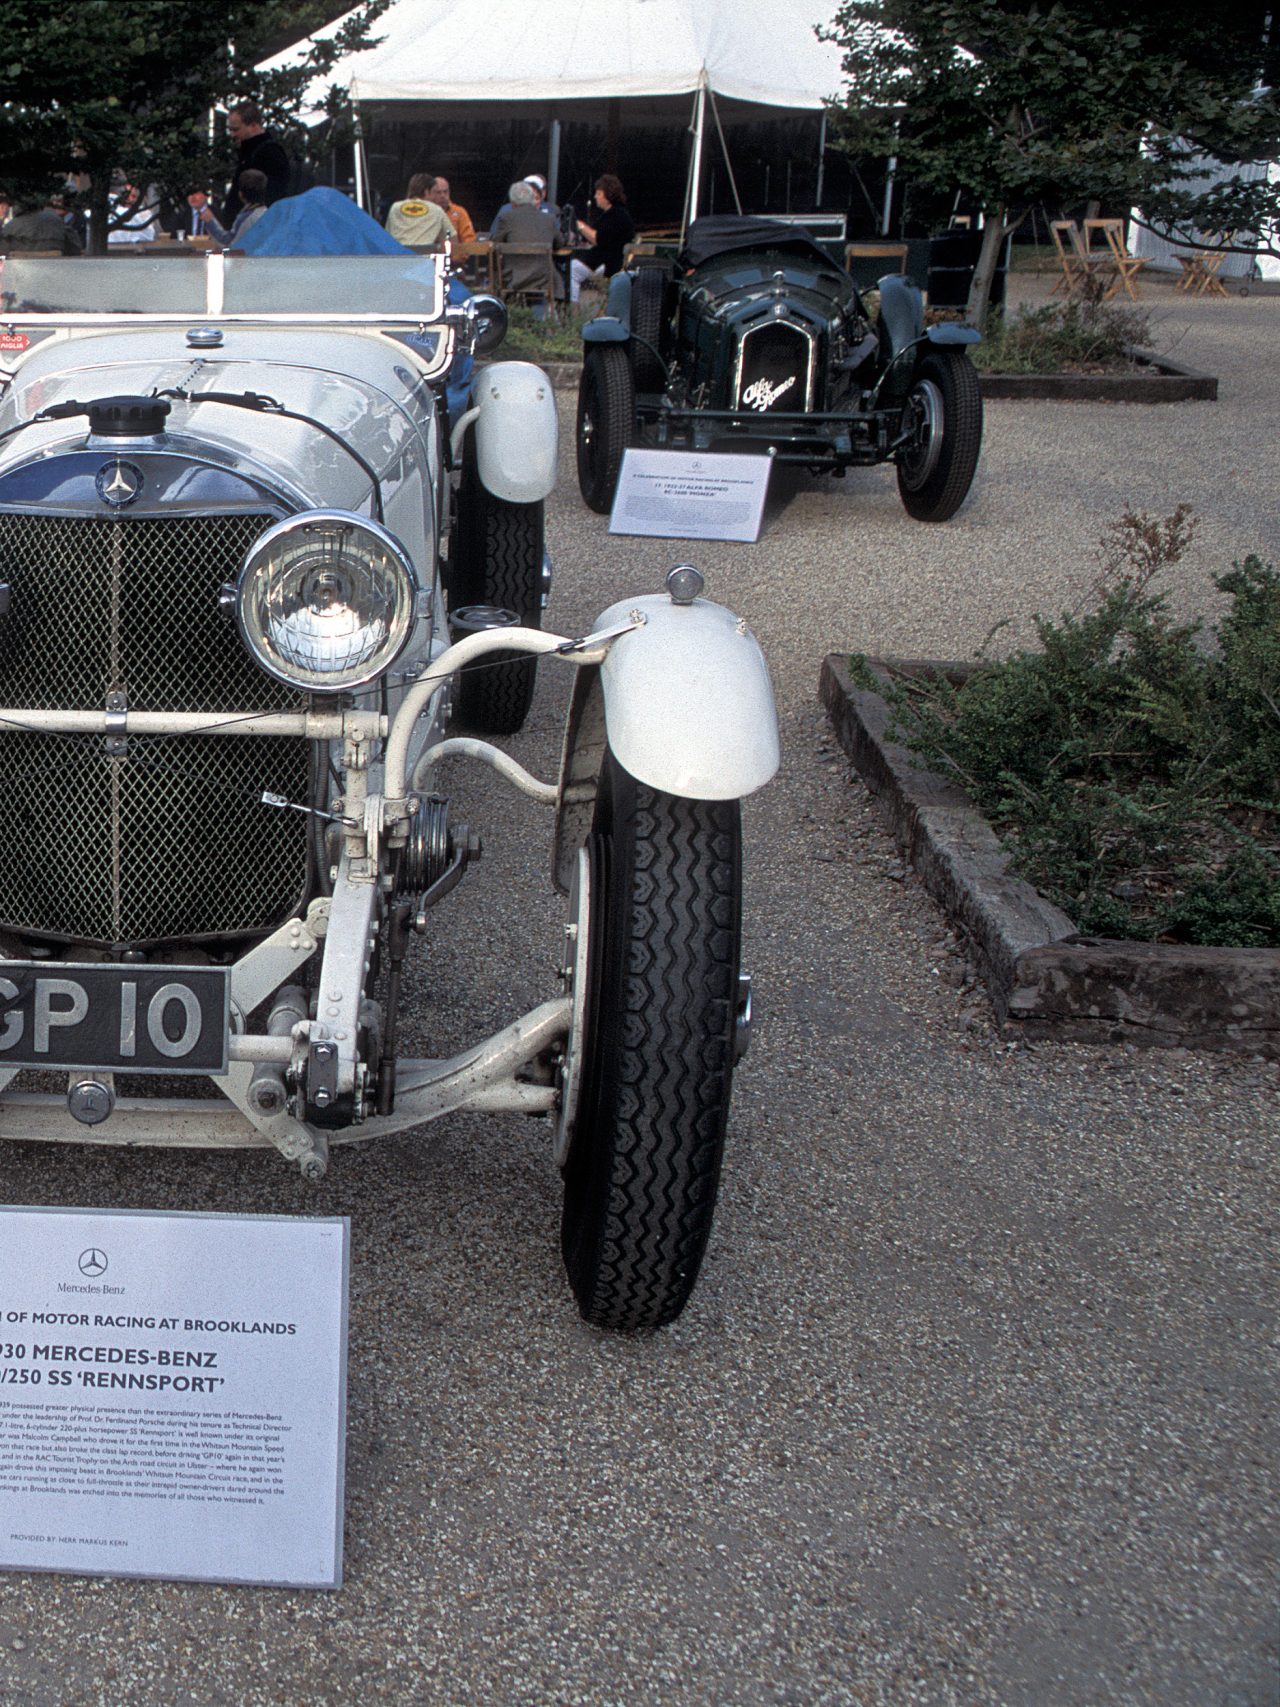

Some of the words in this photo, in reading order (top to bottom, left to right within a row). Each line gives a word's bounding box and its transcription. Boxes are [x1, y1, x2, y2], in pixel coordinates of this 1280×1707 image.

[120, 981, 203, 1059] 10
[57, 1282, 126, 1295] Mercedes-Benz
[6, 1311, 28, 1323] OF
[32, 1312, 90, 1326] MOTOR
[94, 1315, 156, 1329] RACING
[158, 1318, 179, 1330] AT
[184, 1319, 297, 1335] BROOKLANDS
[32, 1344, 218, 1368] MERCEDES-BENZ
[47, 1370, 73, 1386] SS
[1, 1410, 21, 1418] under
[22, 1411, 34, 1419] the
[35, 1412, 68, 1422] leadership
[105, 1415, 138, 1424] Ferdinand
[138, 1417, 166, 1425] Porsche
[166, 1418, 188, 1428] during
[200, 1420, 222, 1428] tenure
[232, 1422, 262, 1430] Technical
[262, 1423, 292, 1431] Director
[11, 1401, 44, 1411] possessed
[45, 1402, 69, 1412] greater
[70, 1404, 95, 1414] physical
[96, 1406, 126, 1415] presence
[127, 1406, 142, 1414] than
[143, 1407, 155, 1415] the
[156, 1408, 201, 1419] extraordinary
[202, 1410, 222, 1418] series
[231, 1411, 282, 1421] Mercedes-Benz
[26, 1422, 58, 1432] 6-cylinder
[88, 1425, 129, 1436] horsepower
[177, 1429, 184, 1437] is
[199, 1430, 223, 1439] known
[224, 1432, 243, 1440] under
[255, 1433, 280, 1443] original
[21, 1432, 49, 1440] Malcolm
[50, 1433, 82, 1444] Campbell
[83, 1435, 97, 1443] who
[98, 1436, 118, 1444] drove
[125, 1437, 136, 1445] for
[149, 1438, 163, 1446] first
[164, 1439, 180, 1447] time
[189, 1440, 201, 1448] the
[201, 1441, 230, 1449] Whitsun
[231, 1442, 263, 1451] Mountain
[264, 1444, 284, 1454] Speed
[41, 1443, 53, 1451] but
[68, 1445, 88, 1453] broke
[118, 1447, 129, 1456] lap
[154, 1449, 177, 1457] before
[177, 1450, 201, 1460] driving
[224, 1453, 242, 1462] again
[251, 1454, 265, 1462] that
[1, 1451, 14, 1459] and
[23, 1452, 34, 1460] the
[10, 1533, 45, 1542] PROVIDED
[78, 1538, 107, 1546] MARKUS
